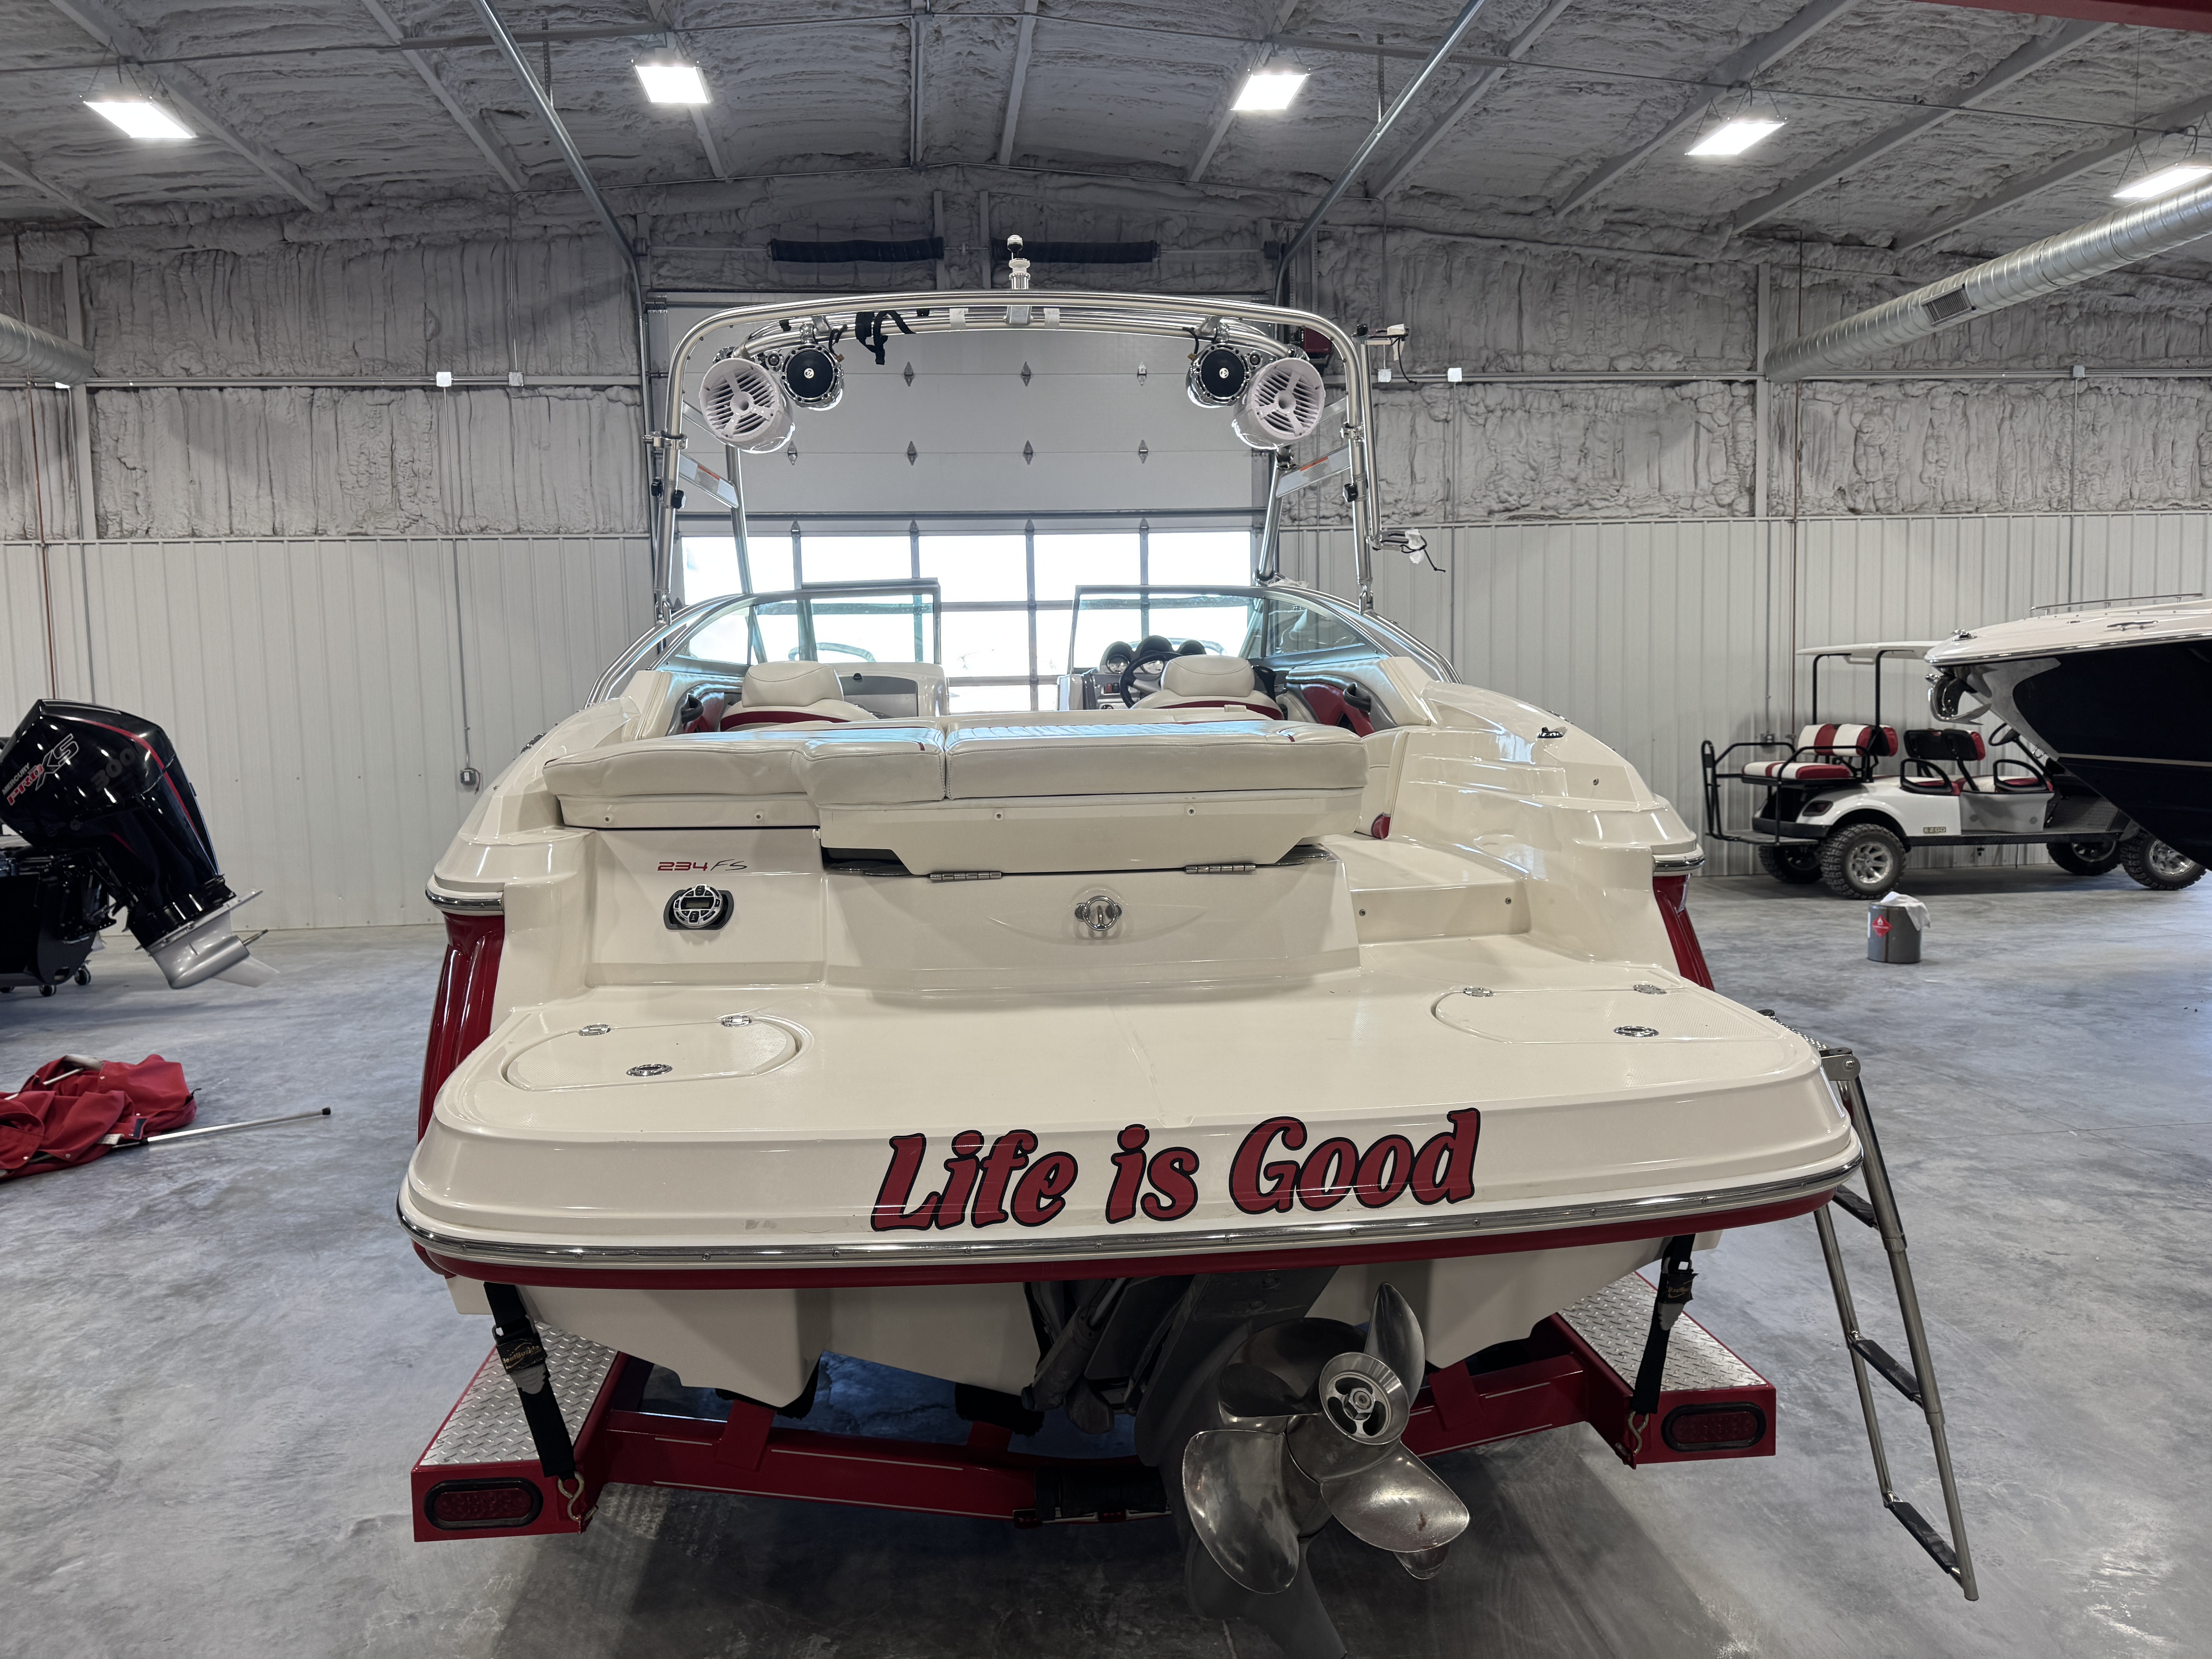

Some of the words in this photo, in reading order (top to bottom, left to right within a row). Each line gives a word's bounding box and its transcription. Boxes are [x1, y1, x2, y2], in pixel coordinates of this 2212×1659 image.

[2, 763, 30, 795] MERCURY
[91, 748, 136, 793] 300
[657, 862, 708, 871] 234
[710, 859, 747, 871] FS
[871, 1128, 1077, 1232] Life
[1105, 1123, 1198, 1224] is
[1228, 1107, 1481, 1214] Good
